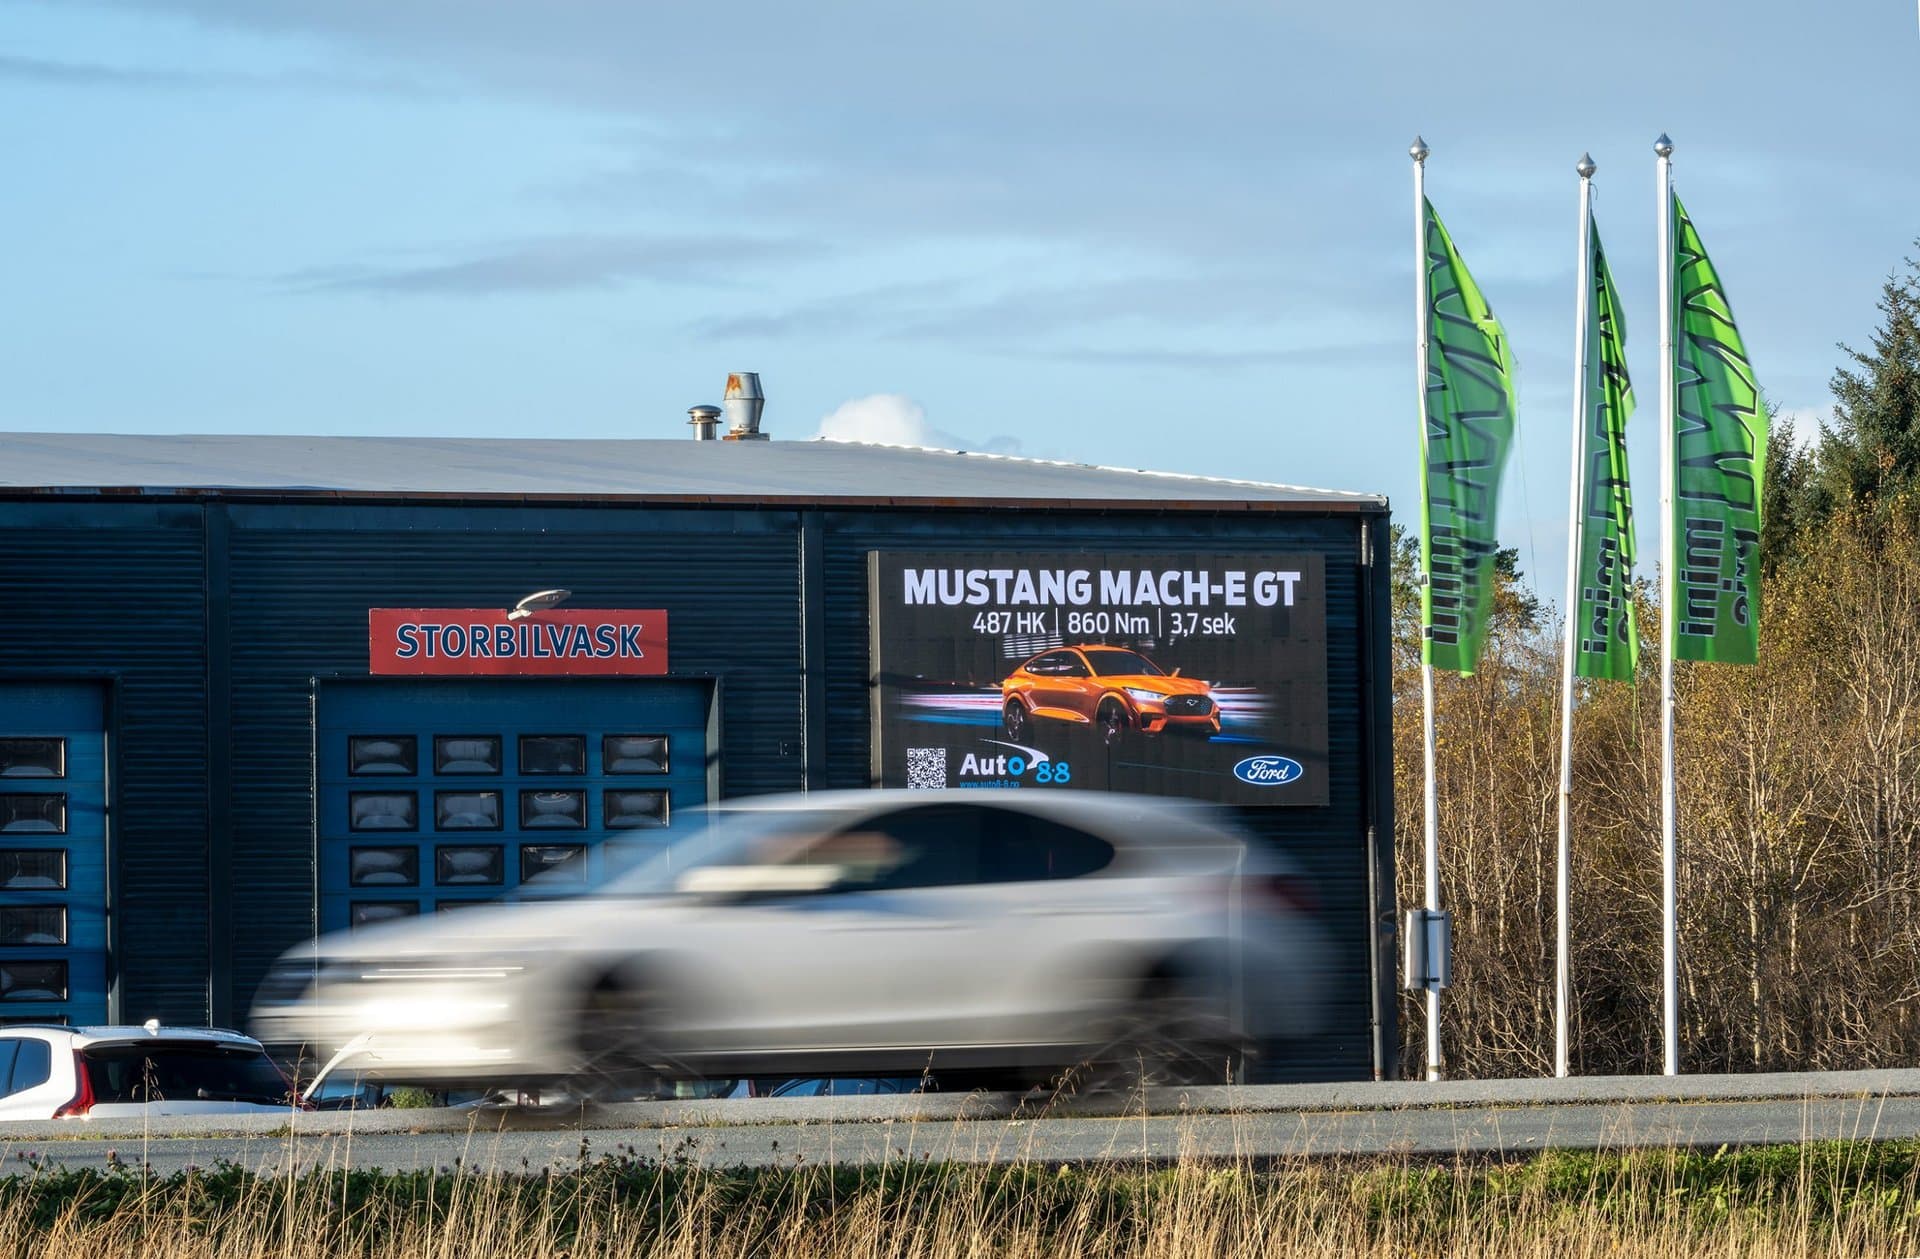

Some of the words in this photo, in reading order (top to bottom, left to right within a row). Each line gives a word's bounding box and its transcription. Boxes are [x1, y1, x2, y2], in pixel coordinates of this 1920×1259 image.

[904, 569, 1091, 606] MUSTANG
[1100, 571, 1246, 606] MACH-E
[1253, 571, 1300, 607] GT
[973, 612, 1012, 634] 487
[1017, 613, 1046, 634] HK
[1068, 612, 1109, 634] 860
[1115, 613, 1149, 634] Nm
[1170, 613, 1198, 637] 3,7
[1202, 612, 1236, 634] sek
[396, 623, 644, 659] STORBILVASK
[1246, 762, 1288, 782] Ford
